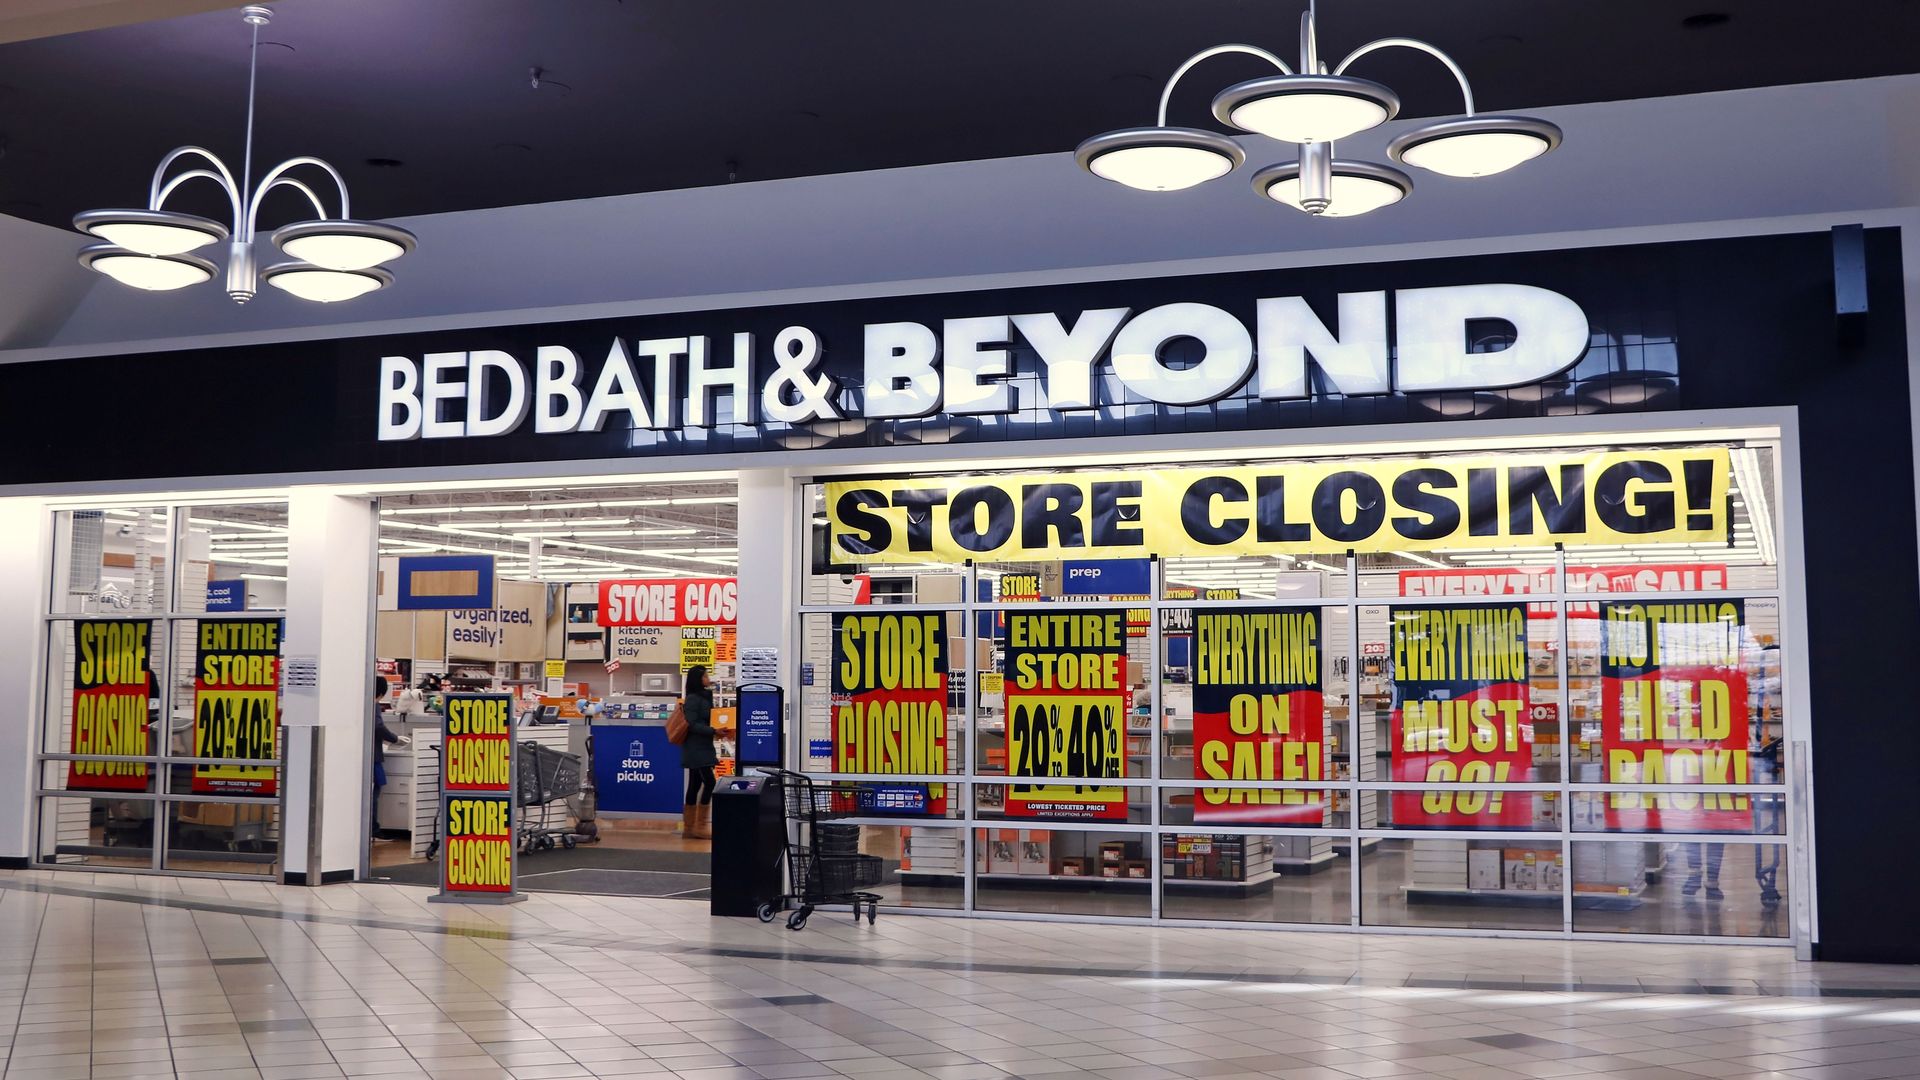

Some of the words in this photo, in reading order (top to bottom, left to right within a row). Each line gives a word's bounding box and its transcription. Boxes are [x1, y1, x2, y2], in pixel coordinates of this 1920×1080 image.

[377, 349, 530, 442] BED
[534, 327, 754, 434] BATH
[763, 325, 845, 423] &
[862, 283, 1591, 418] BEYOND
[836, 479, 1145, 553] STORE
[1180, 459, 1715, 545] CLOSING!
[1002, 575, 1038, 596] STORE
[1069, 567, 1102, 579] prep
[453, 605, 532, 627] organized,
[608, 584, 676, 623] STORE
[80, 622, 147, 685] STORE
[201, 623, 278, 650] ENTIRE
[618, 626, 663, 636] kitchen,
[618, 637, 648, 646] clean
[650, 637, 658, 646] &
[618, 647, 640, 657] tidy
[682, 628, 696, 639] FOR
[697, 628, 714, 639] SALE
[841, 614, 941, 690] STORE
[1010, 614, 1121, 648] ENTIRE
[1197, 611, 1317, 686] EVERYTHING
[1394, 606, 1525, 681] EVERYTHING
[1607, 602, 1740, 668] NOTHING
[204, 655, 275, 686] STORE
[1016, 652, 1120, 690] STORE
[449, 699, 508, 735] STORE
[1229, 693, 1290, 735] ON
[1403, 699, 1524, 753] MUST
[1622, 679, 1731, 741] HELD
[74, 693, 147, 776] CLOSING
[198, 697, 235, 772] 20%
[236, 697, 271, 773] 40%
[838, 699, 944, 800] CLOSING
[1013, 703, 1064, 793] 20%
[1051, 761, 1062, 780] TO
[1067, 704, 1117, 794] 40%
[447, 738, 510, 784] CLOSING
[617, 770, 655, 784] pickup
[622, 758, 650, 769] store
[1201, 740, 1321, 806] SALE!
[1609, 748, 1748, 811] BACK!
[1421, 760, 1511, 815] GO!
[450, 799, 509, 836] STORE
[448, 838, 511, 886] CLOSING
